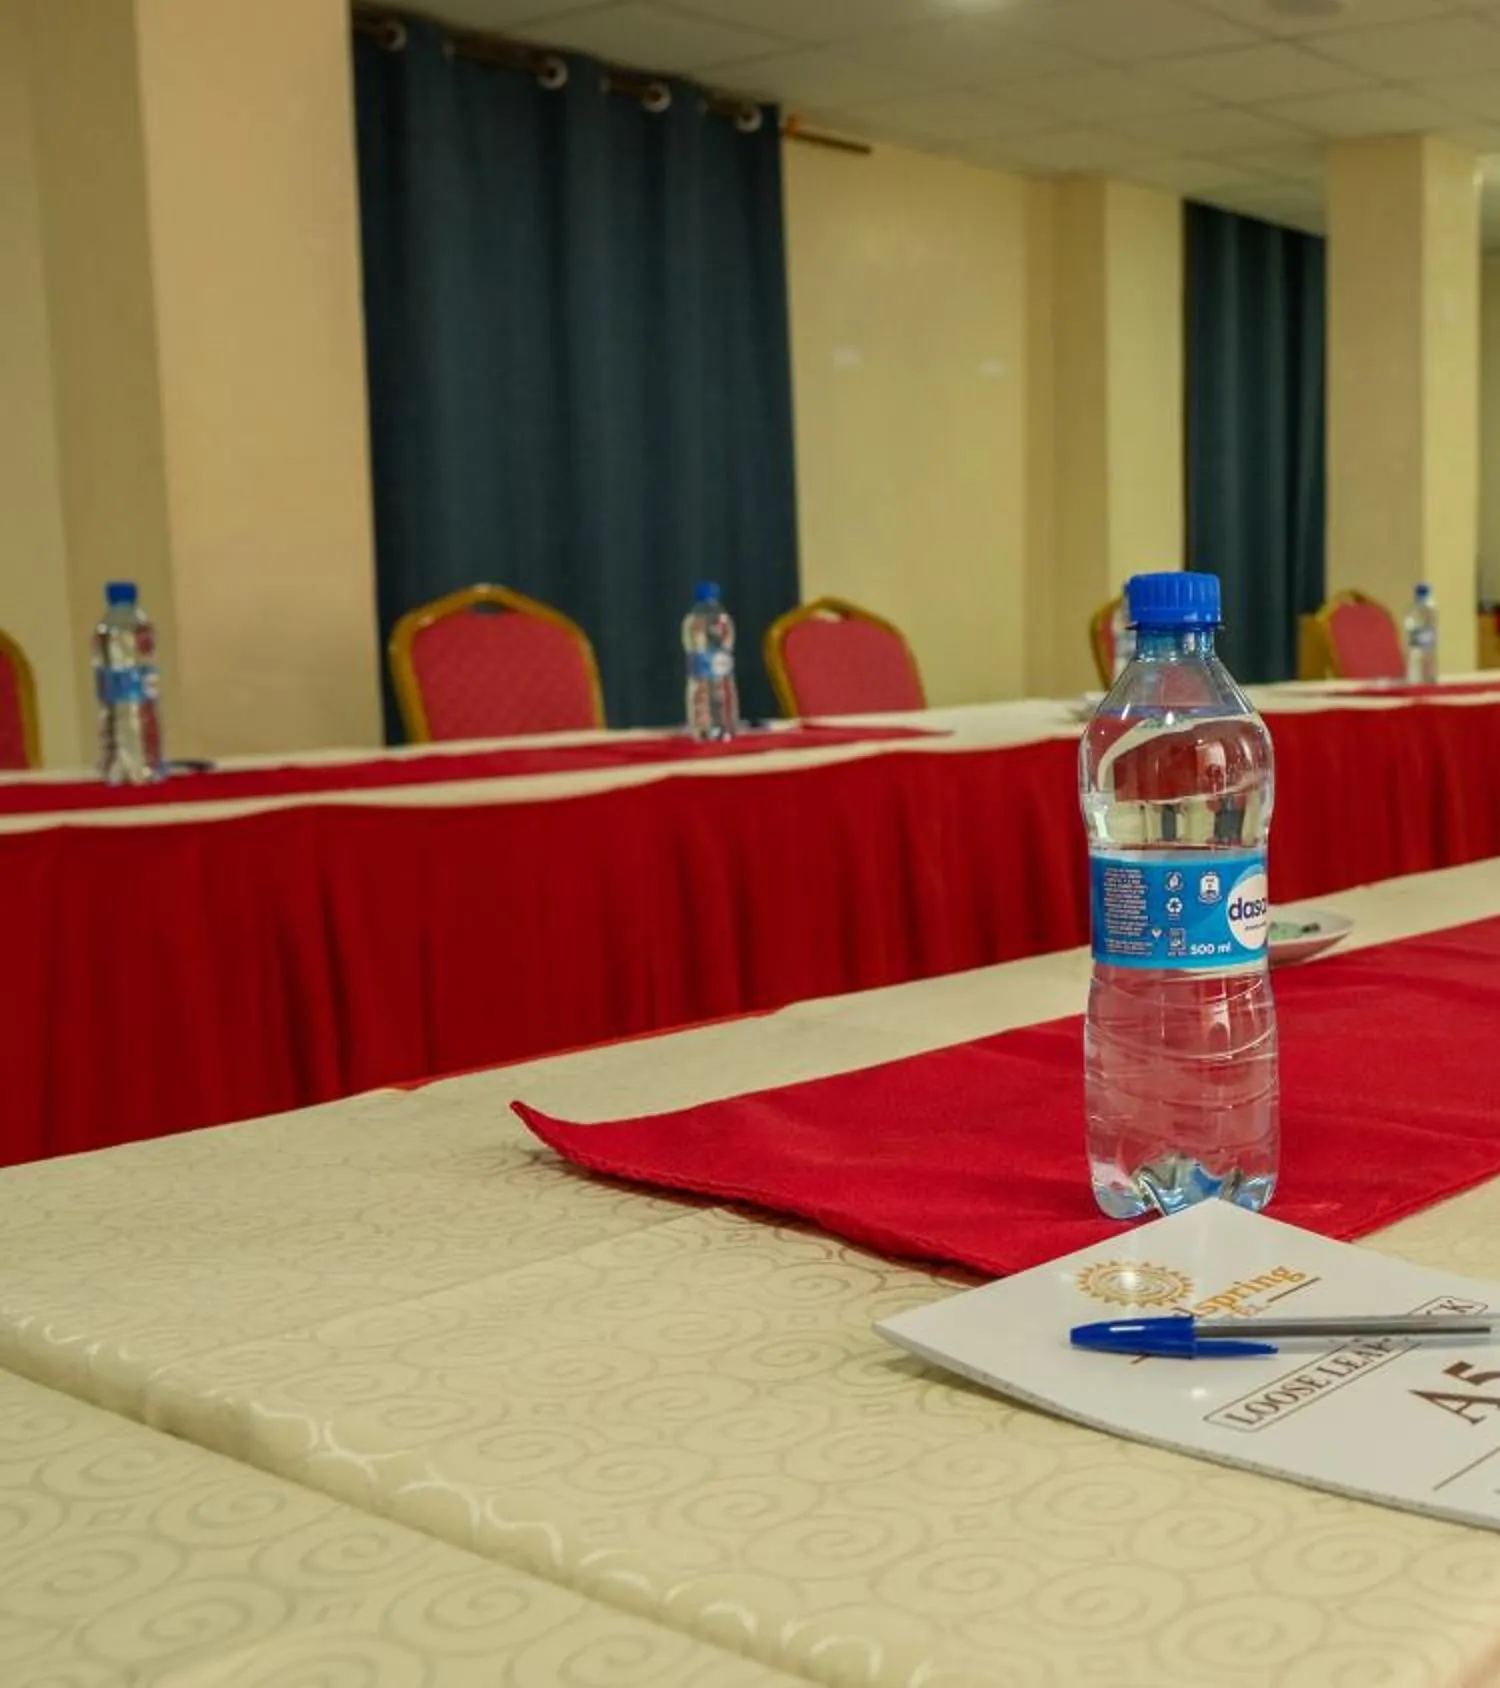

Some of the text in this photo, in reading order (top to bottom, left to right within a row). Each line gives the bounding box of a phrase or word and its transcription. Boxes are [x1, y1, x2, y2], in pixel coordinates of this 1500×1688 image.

[1189, 940, 1232, 955] 500 ml
[1223, 1374, 1330, 1426] LOOSE
